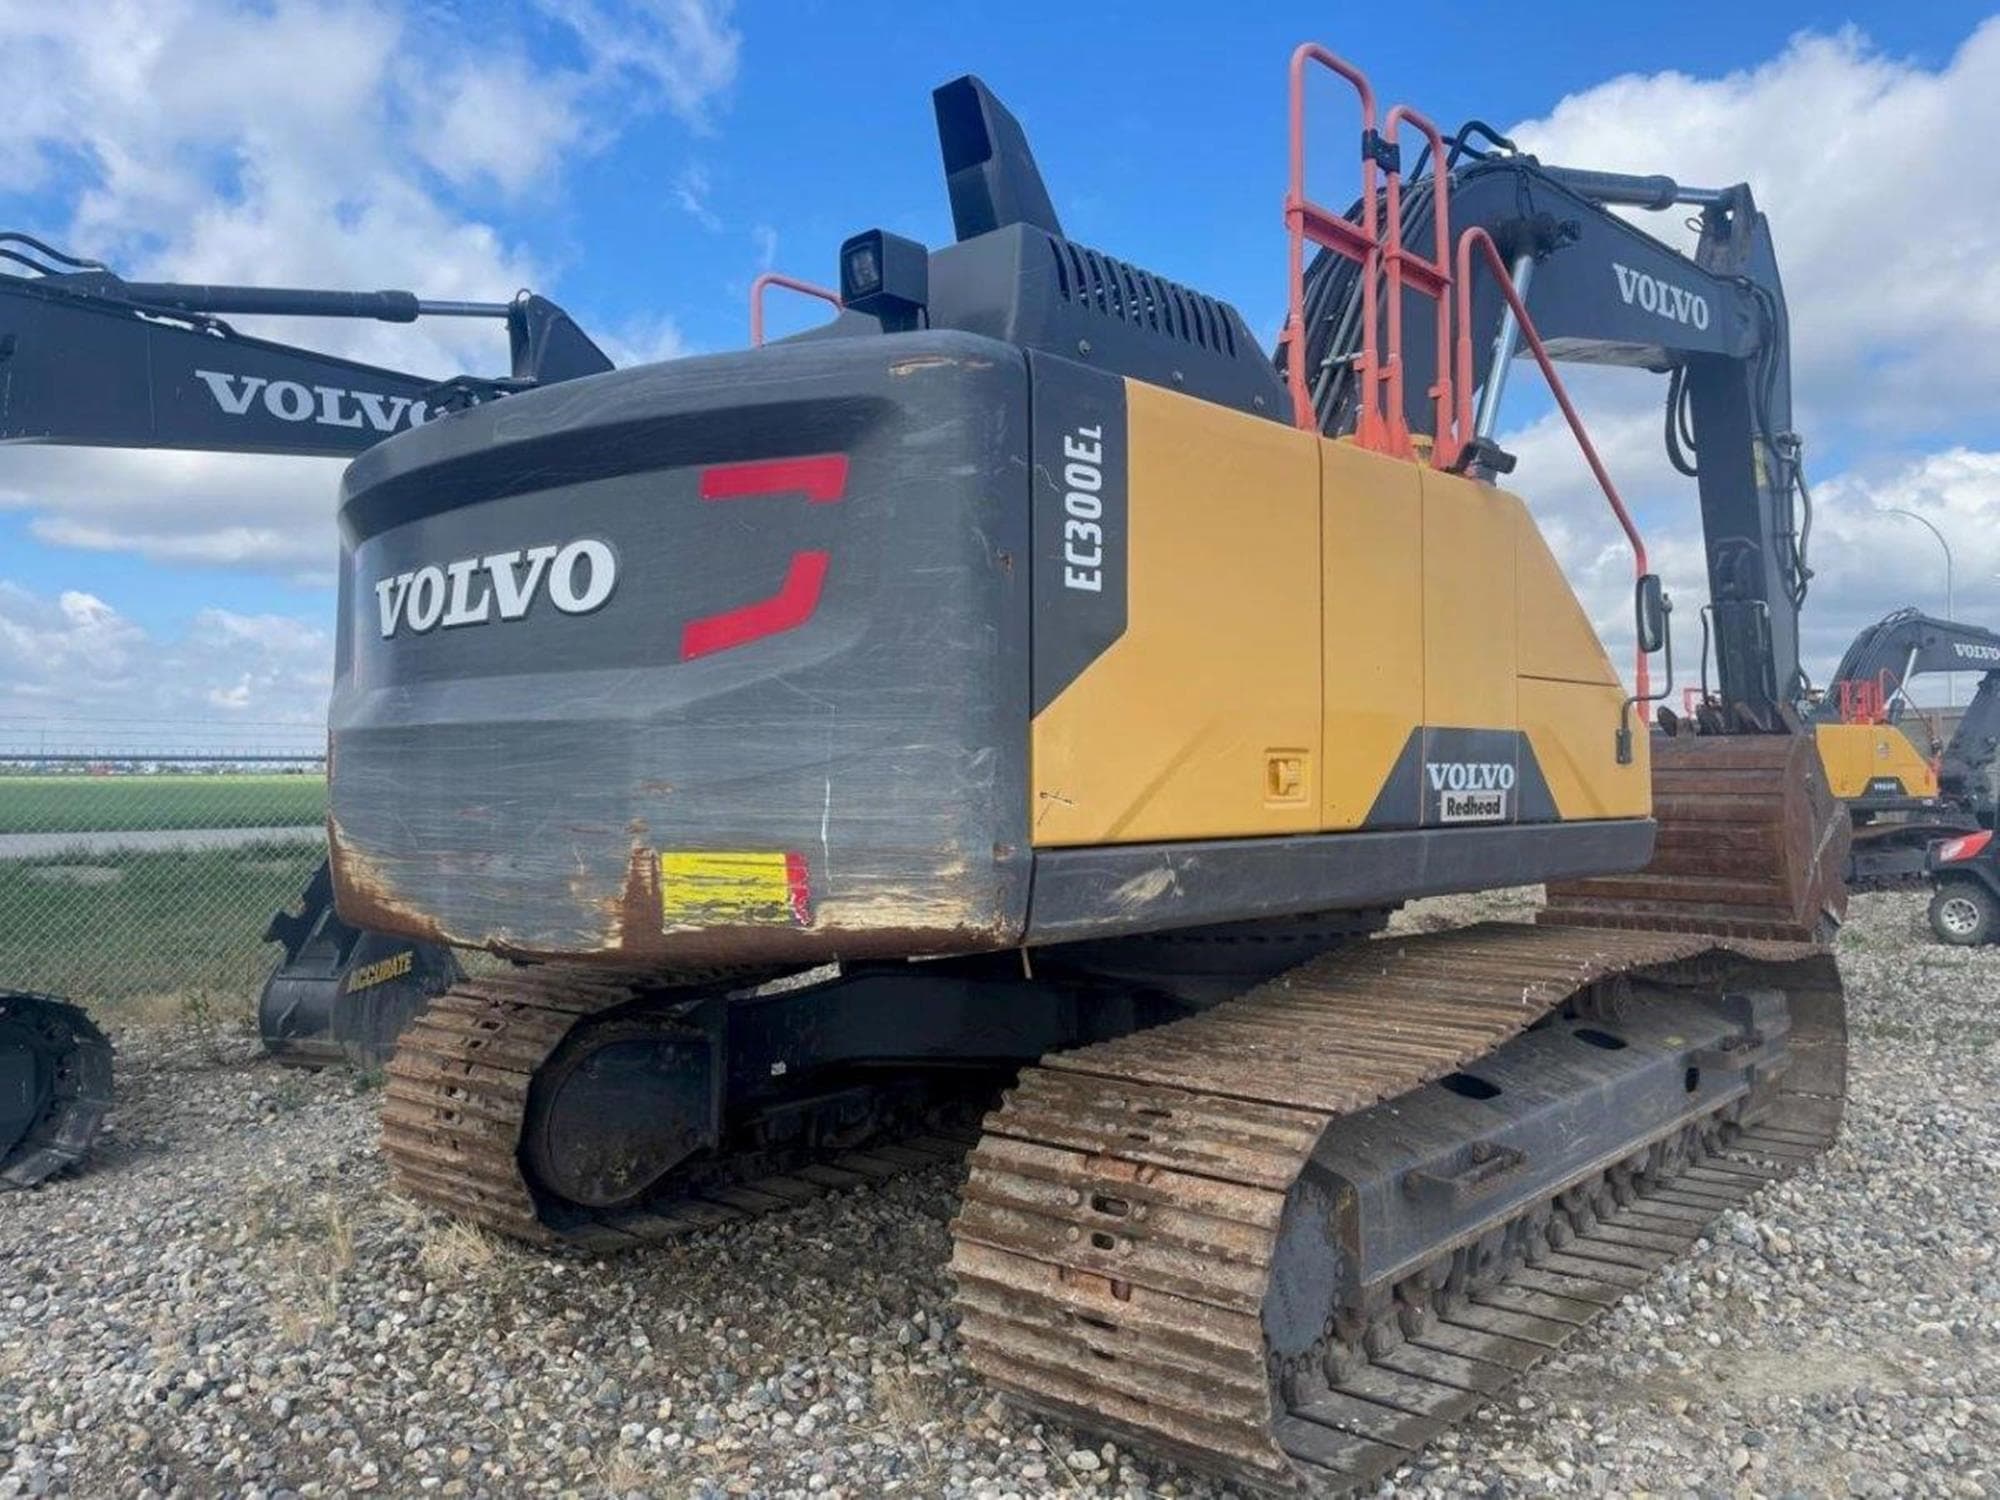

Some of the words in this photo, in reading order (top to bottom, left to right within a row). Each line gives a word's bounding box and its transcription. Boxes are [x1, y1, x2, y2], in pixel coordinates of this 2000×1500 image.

[1612, 262, 1709, 331] VOLVO
[1064, 425, 1103, 592] EC300EL
[375, 539, 616, 638] VOLVO
[1426, 763, 1515, 791] VOLVO
[1447, 795, 1501, 816] Redhead
